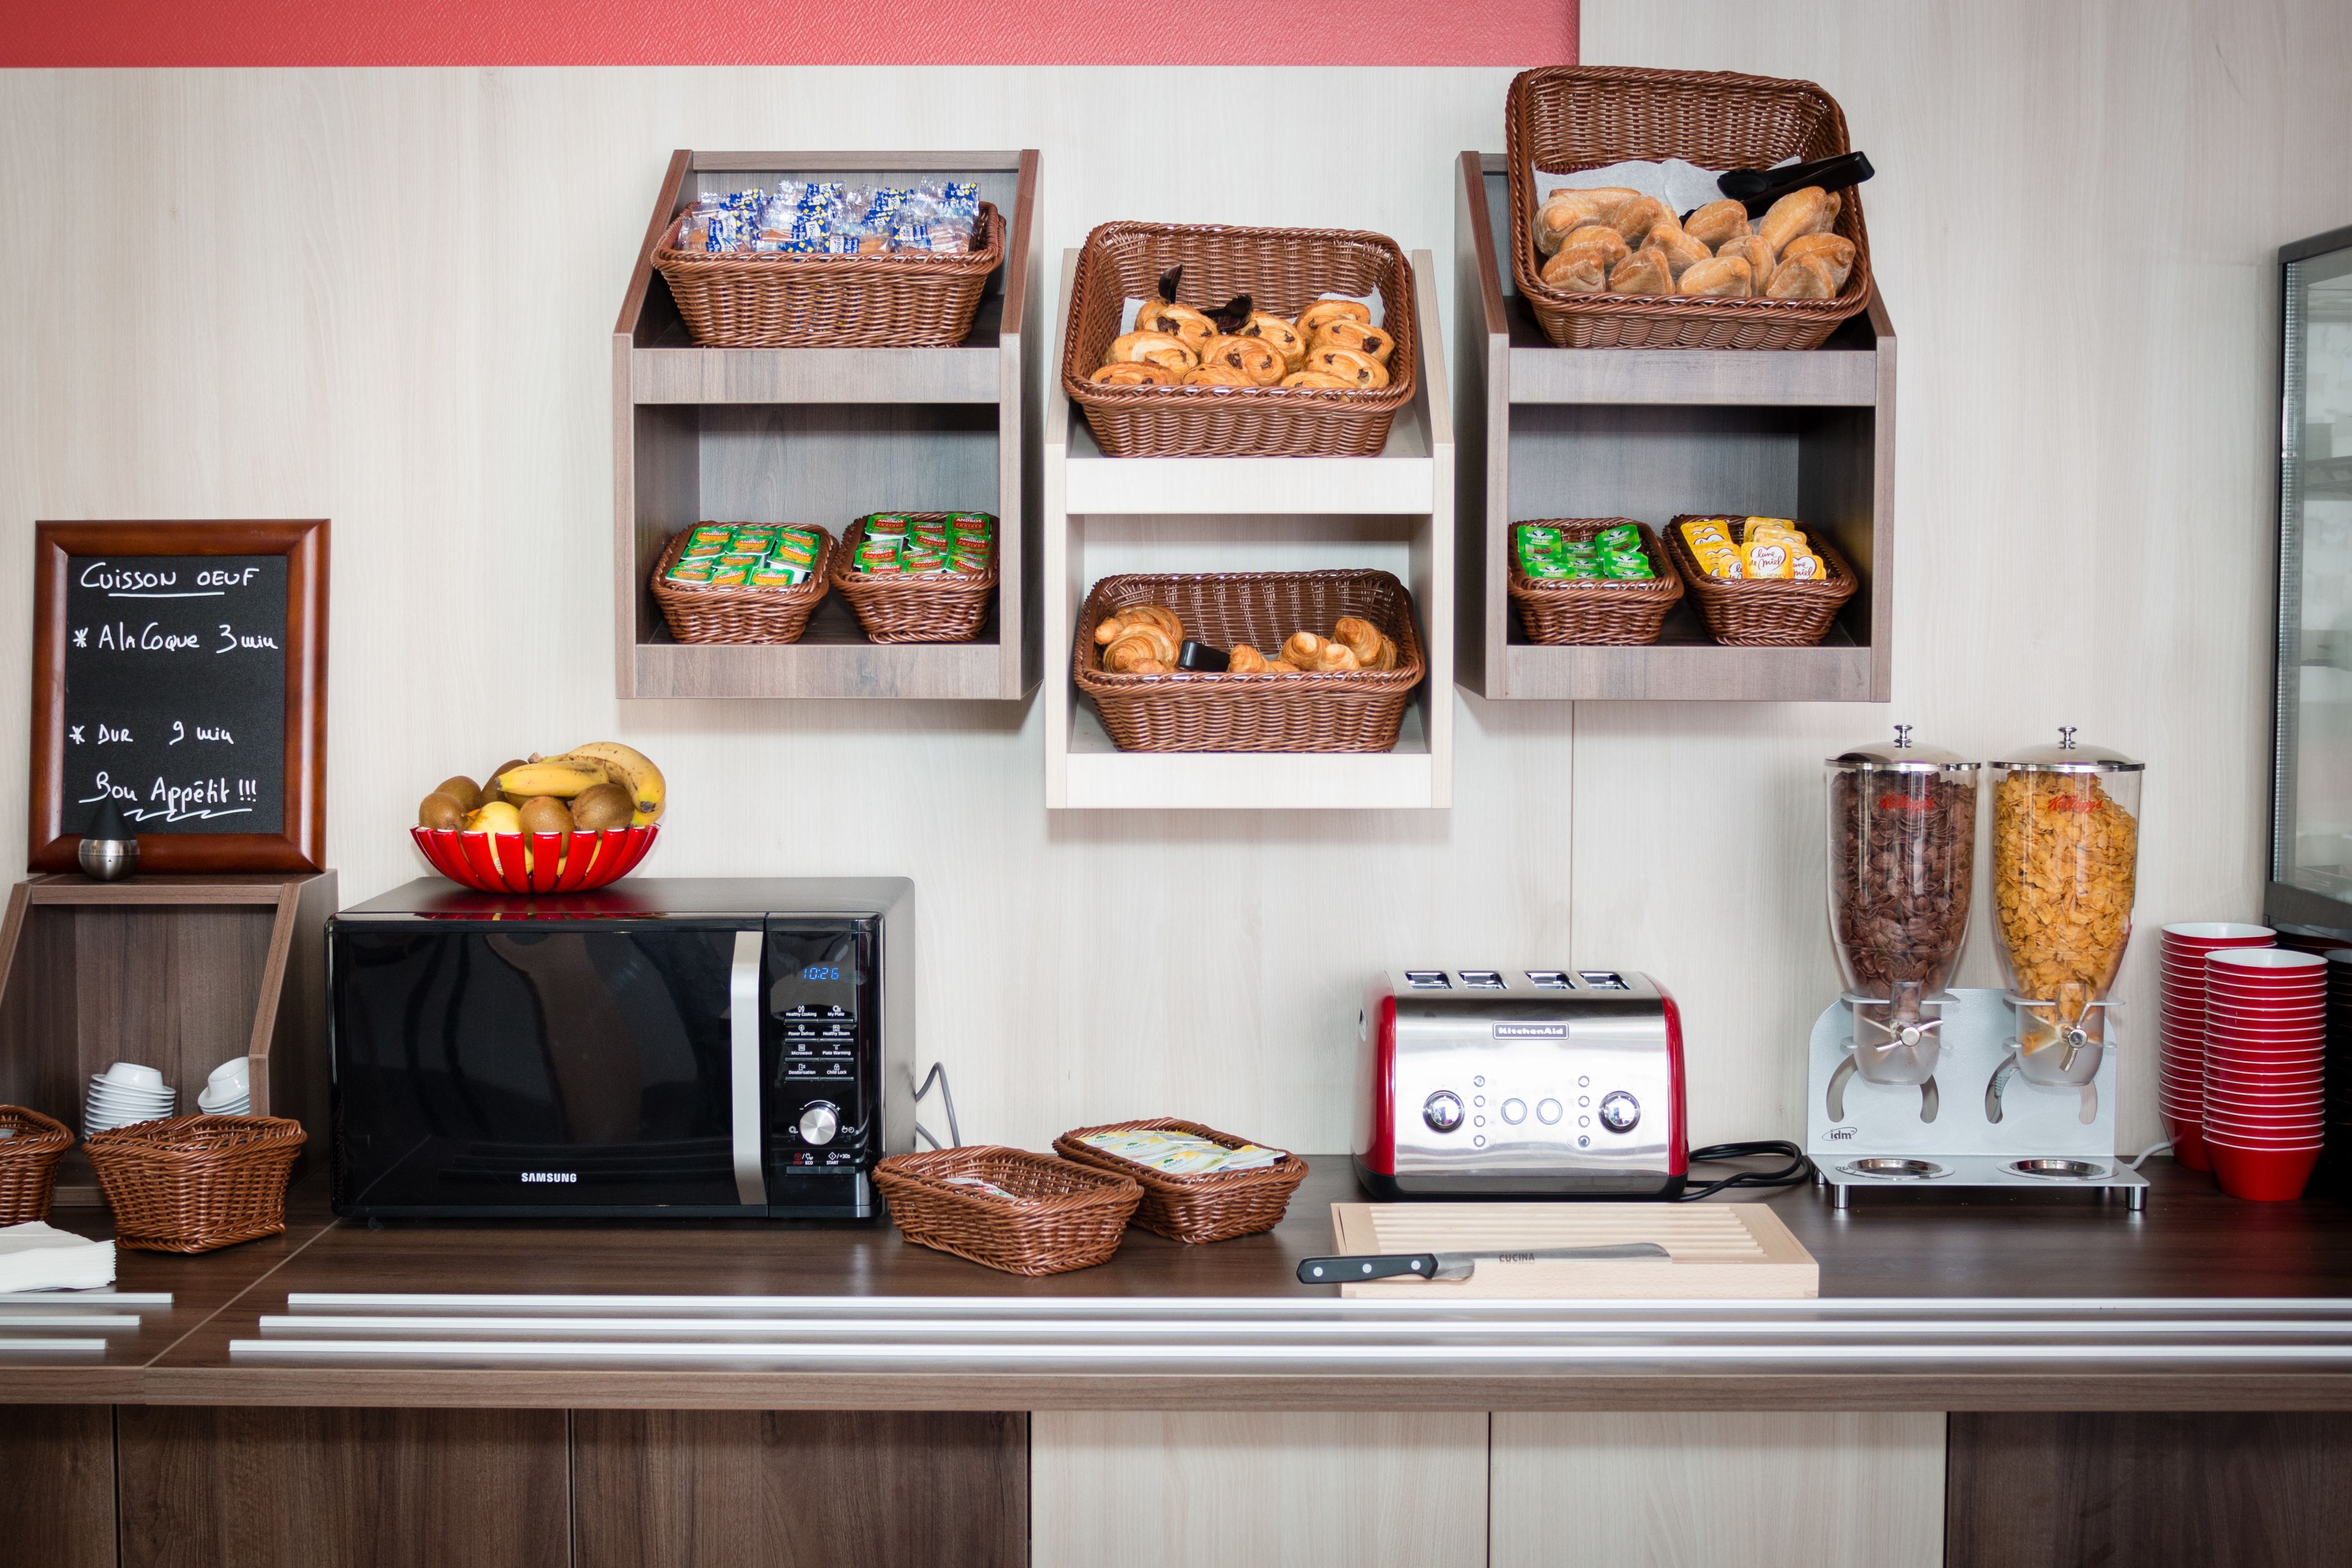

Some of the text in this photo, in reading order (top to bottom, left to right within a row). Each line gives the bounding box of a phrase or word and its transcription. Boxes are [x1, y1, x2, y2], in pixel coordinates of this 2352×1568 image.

[784, 545, 811, 557] ANDROS
[1757, 548, 1776, 557] lune
[958, 560, 984, 570] ANDROS
[1758, 556, 1783, 571] miel
[216, 624, 238, 654] 3
[240, 635, 279, 649] min
[169, 721, 184, 745] 9
[197, 726, 234, 745] min
[2048, 794, 2103, 814] Kellogg's
[803, 967, 839, 980] 10:26
[1830, 1129, 1852, 1140] idm
[521, 1172, 577, 1183] SAMSUNG
[1499, 1253, 1535, 1262] CUCINA
